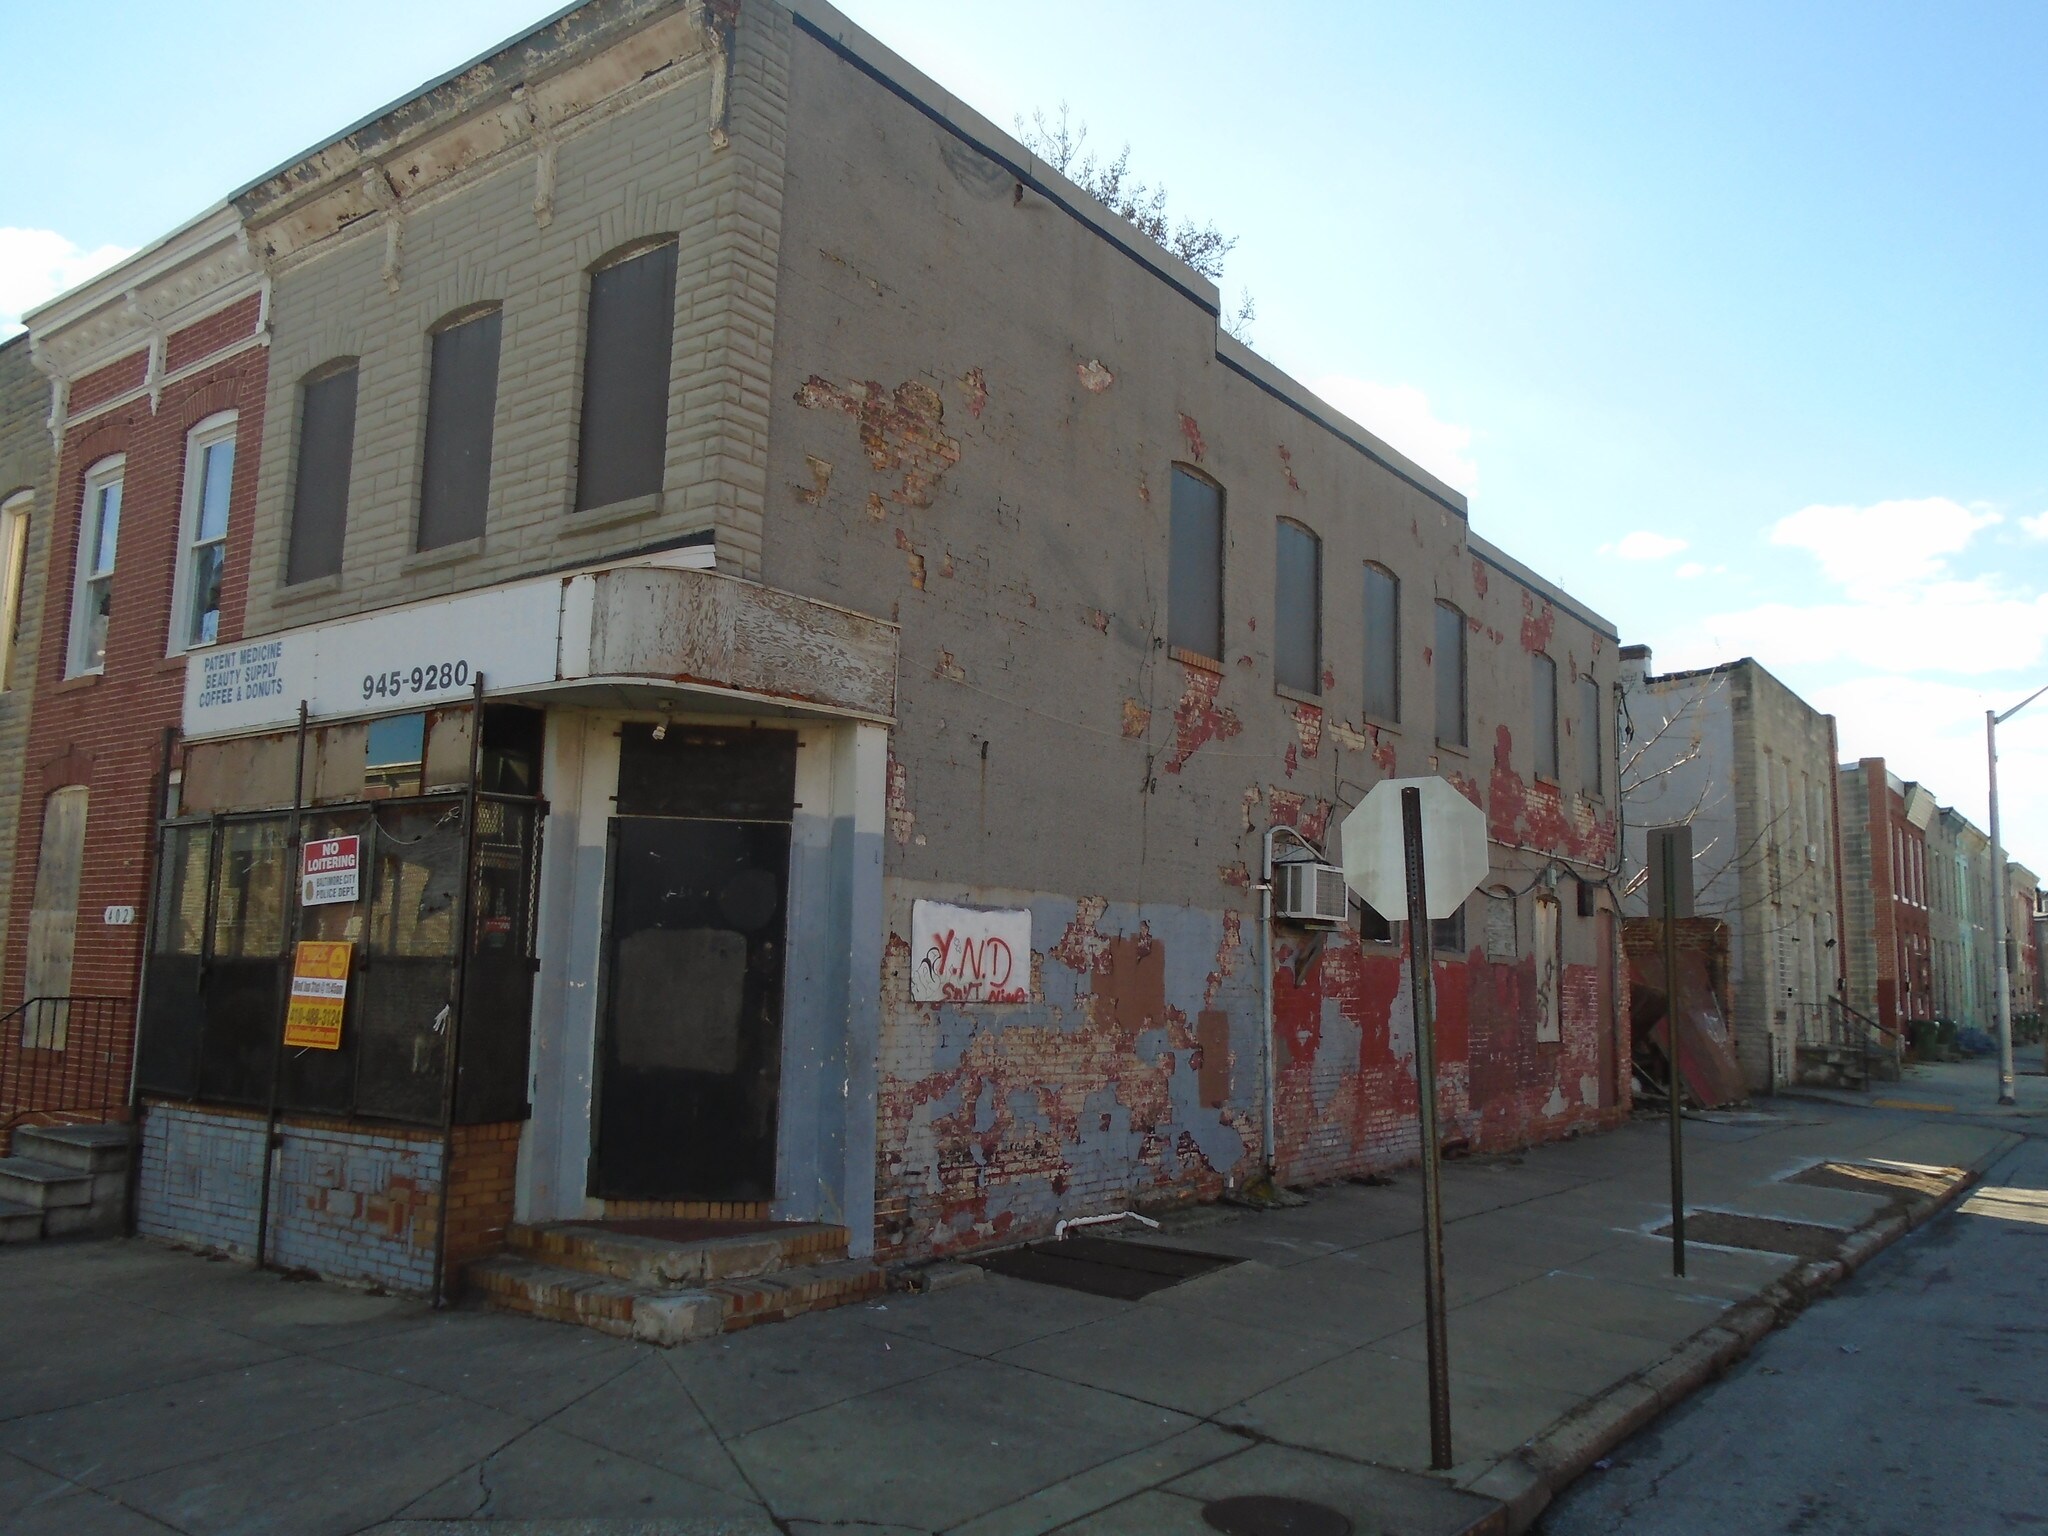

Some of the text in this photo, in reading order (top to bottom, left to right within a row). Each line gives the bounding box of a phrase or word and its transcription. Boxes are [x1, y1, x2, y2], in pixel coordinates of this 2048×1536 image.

[204, 642, 282, 673] PATENT MEDICINE
[206, 661, 278, 690] BEAUTY SUPPLY
[362, 659, 469, 700] 945-9280
[199, 678, 282, 708] COFFEE & DONUTS
[322, 842, 339, 856] NO
[308, 854, 356, 872] LOITERING
[316, 874, 356, 887] BALTIMORE CITY
[316, 888, 337, 899] POLICE
